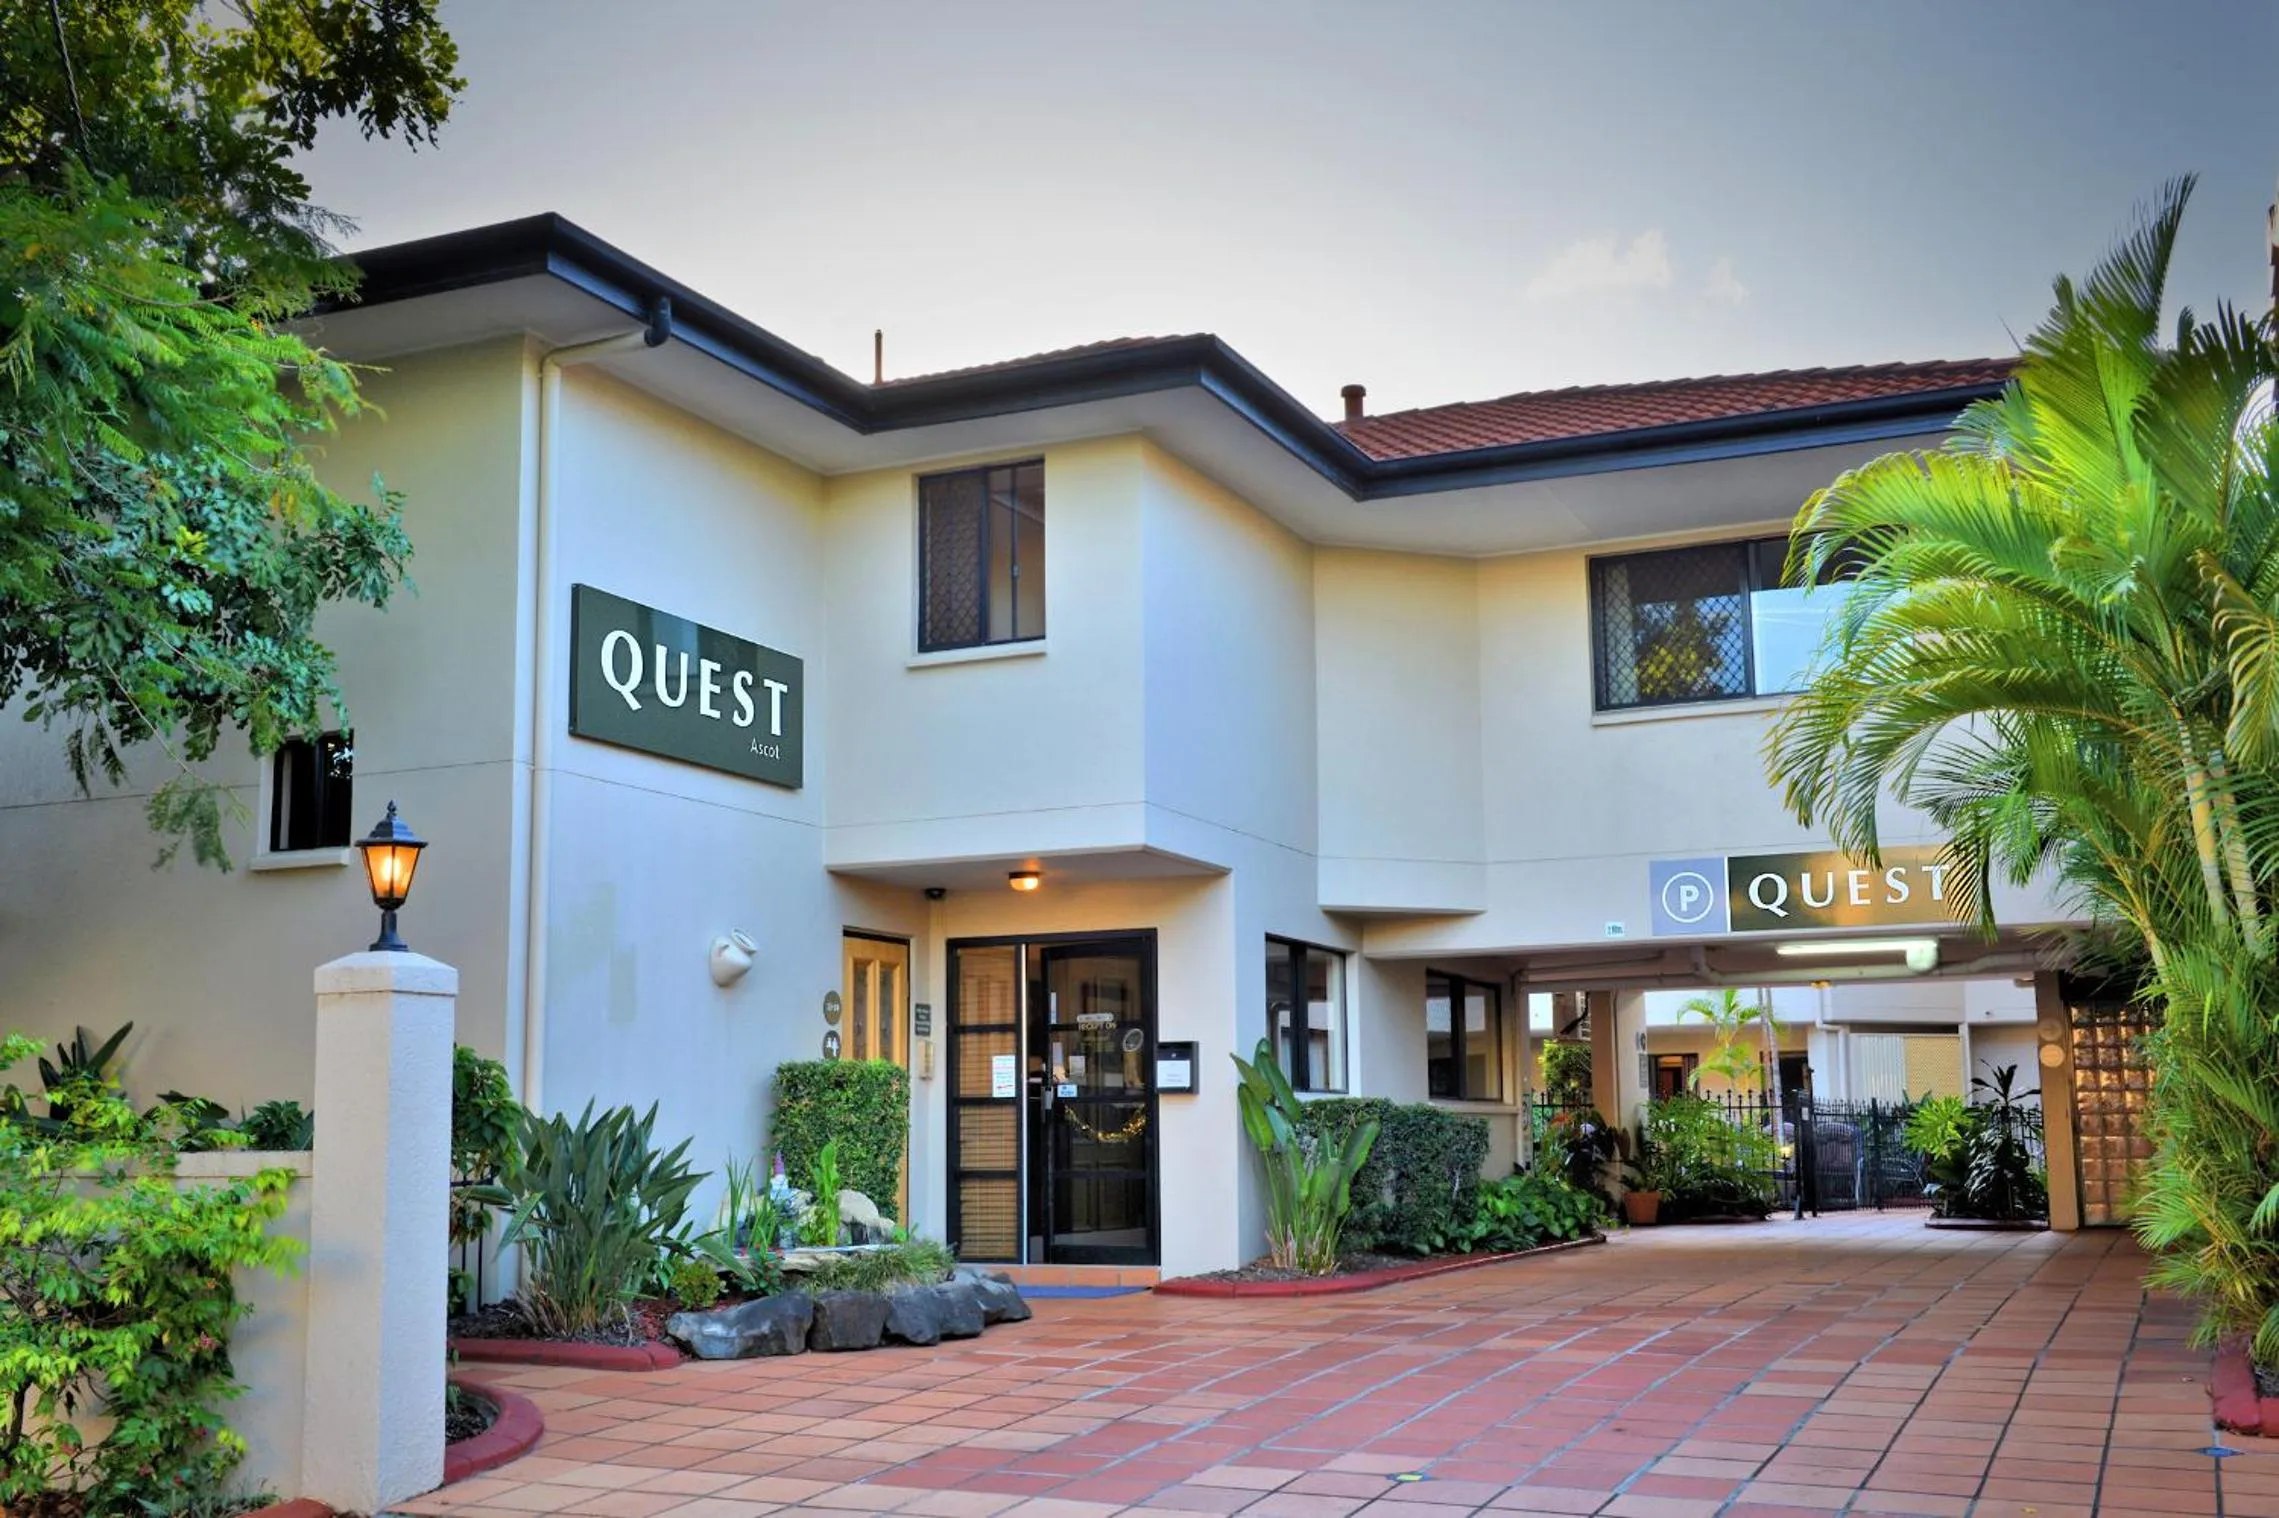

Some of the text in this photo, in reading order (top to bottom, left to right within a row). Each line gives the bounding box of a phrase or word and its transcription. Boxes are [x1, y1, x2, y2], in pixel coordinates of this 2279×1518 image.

[601, 630, 788, 736] QUEST
[750, 738, 780, 760] Ascot
[1679, 885, 1699, 912] P
[1748, 864, 1950, 918] QUEST
